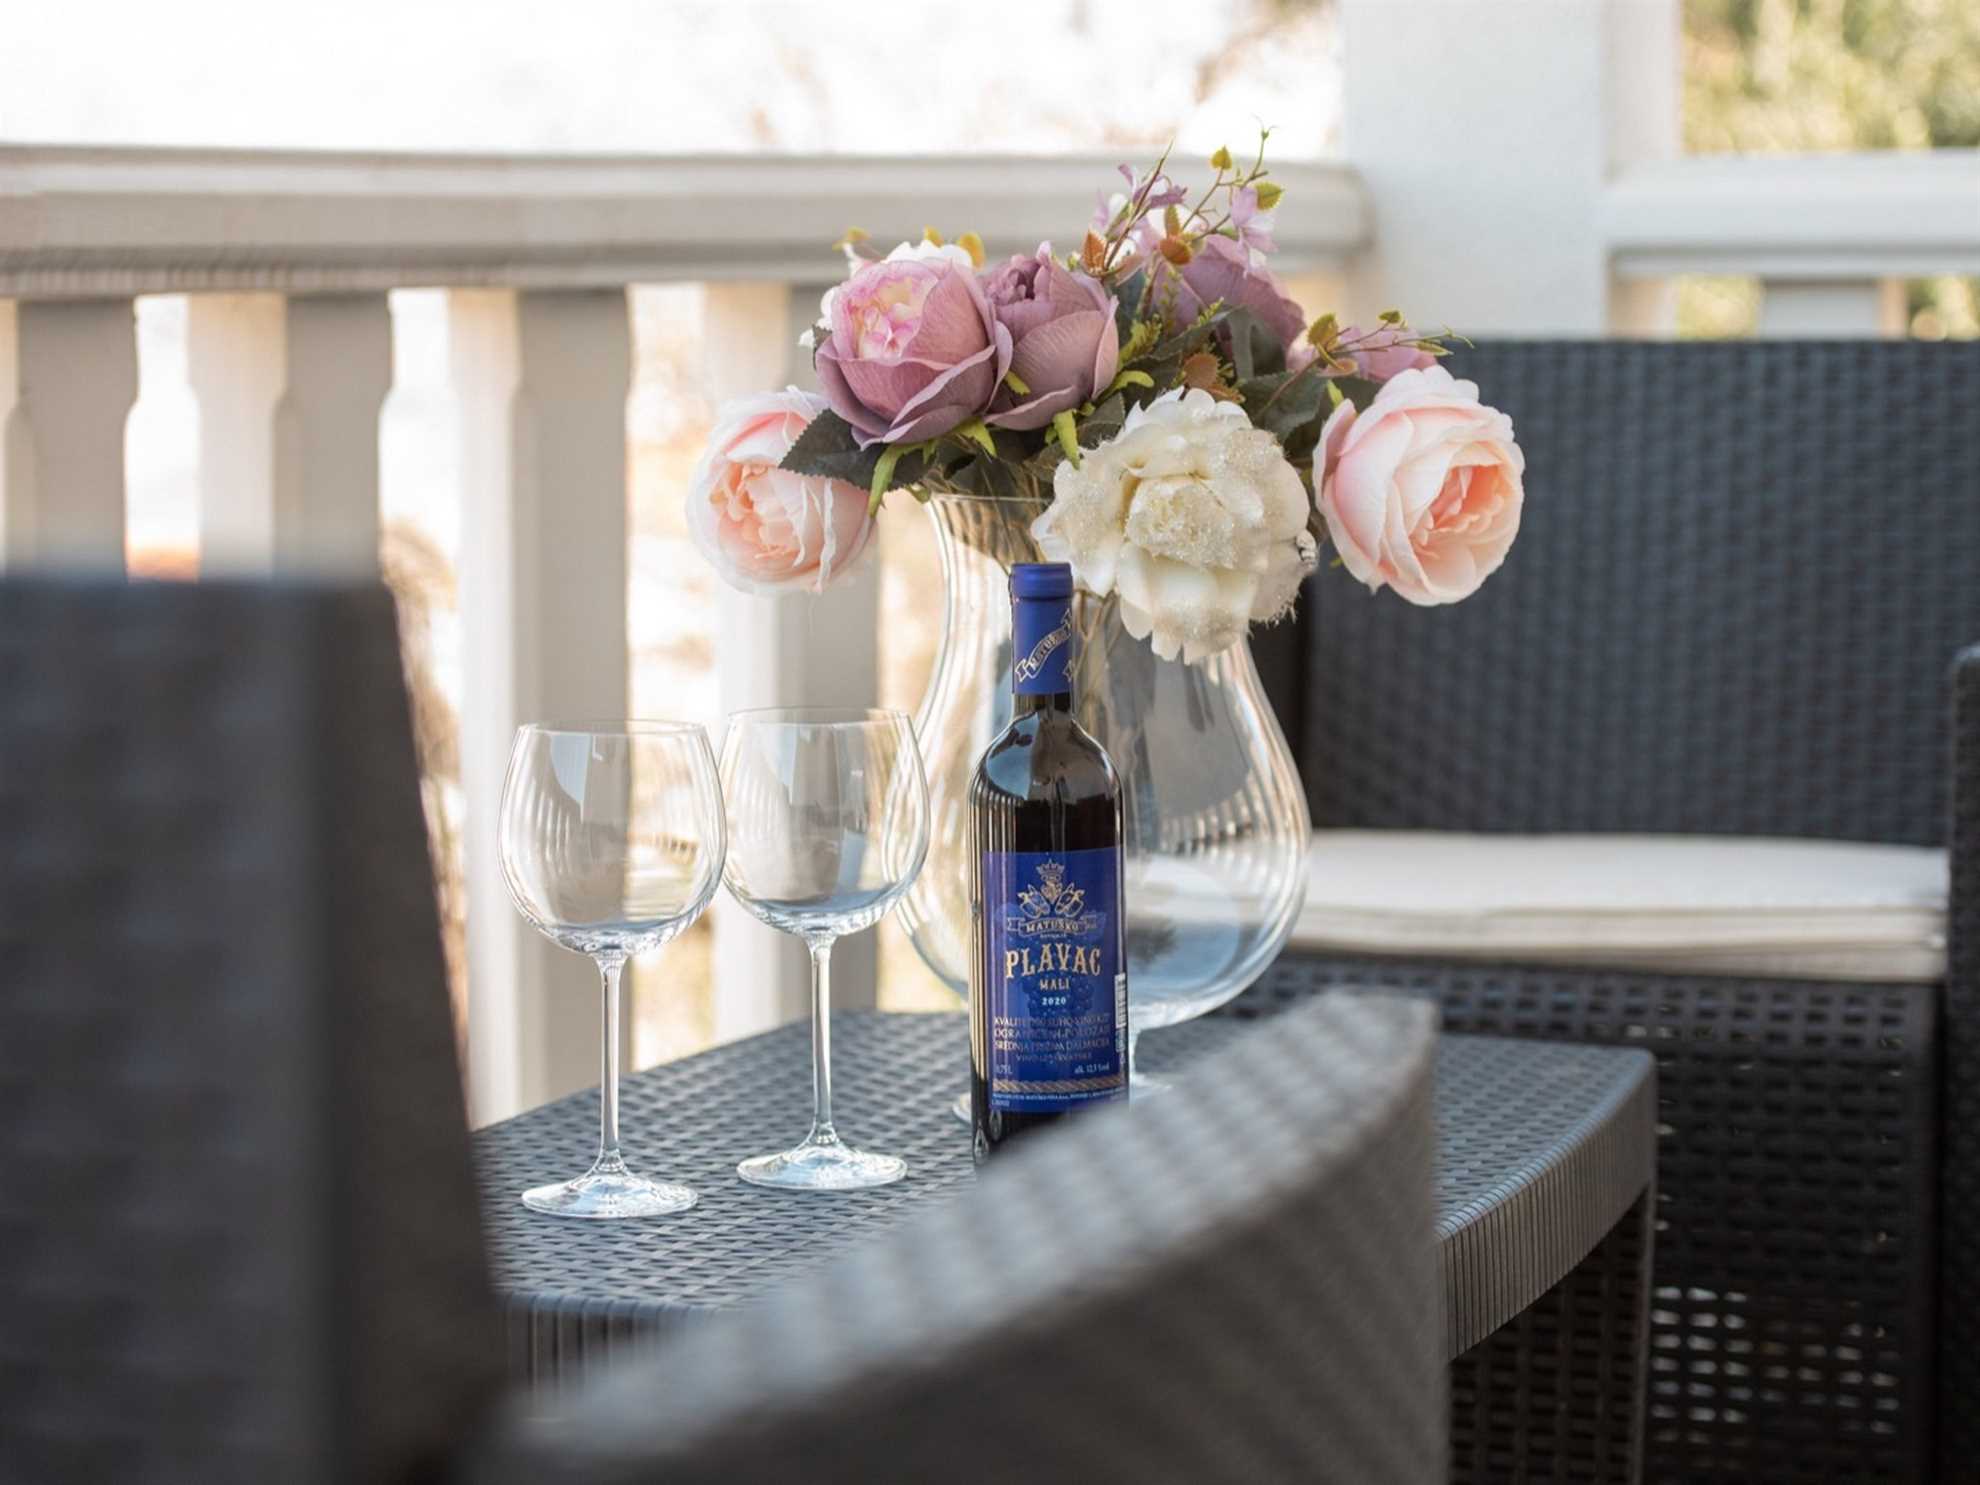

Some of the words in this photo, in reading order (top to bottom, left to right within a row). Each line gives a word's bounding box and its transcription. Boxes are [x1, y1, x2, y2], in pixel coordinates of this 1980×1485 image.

[1005, 943, 1101, 979] PLAVAC
[1039, 978, 1070, 991] MALI
[1042, 997, 1067, 1006] 2020
